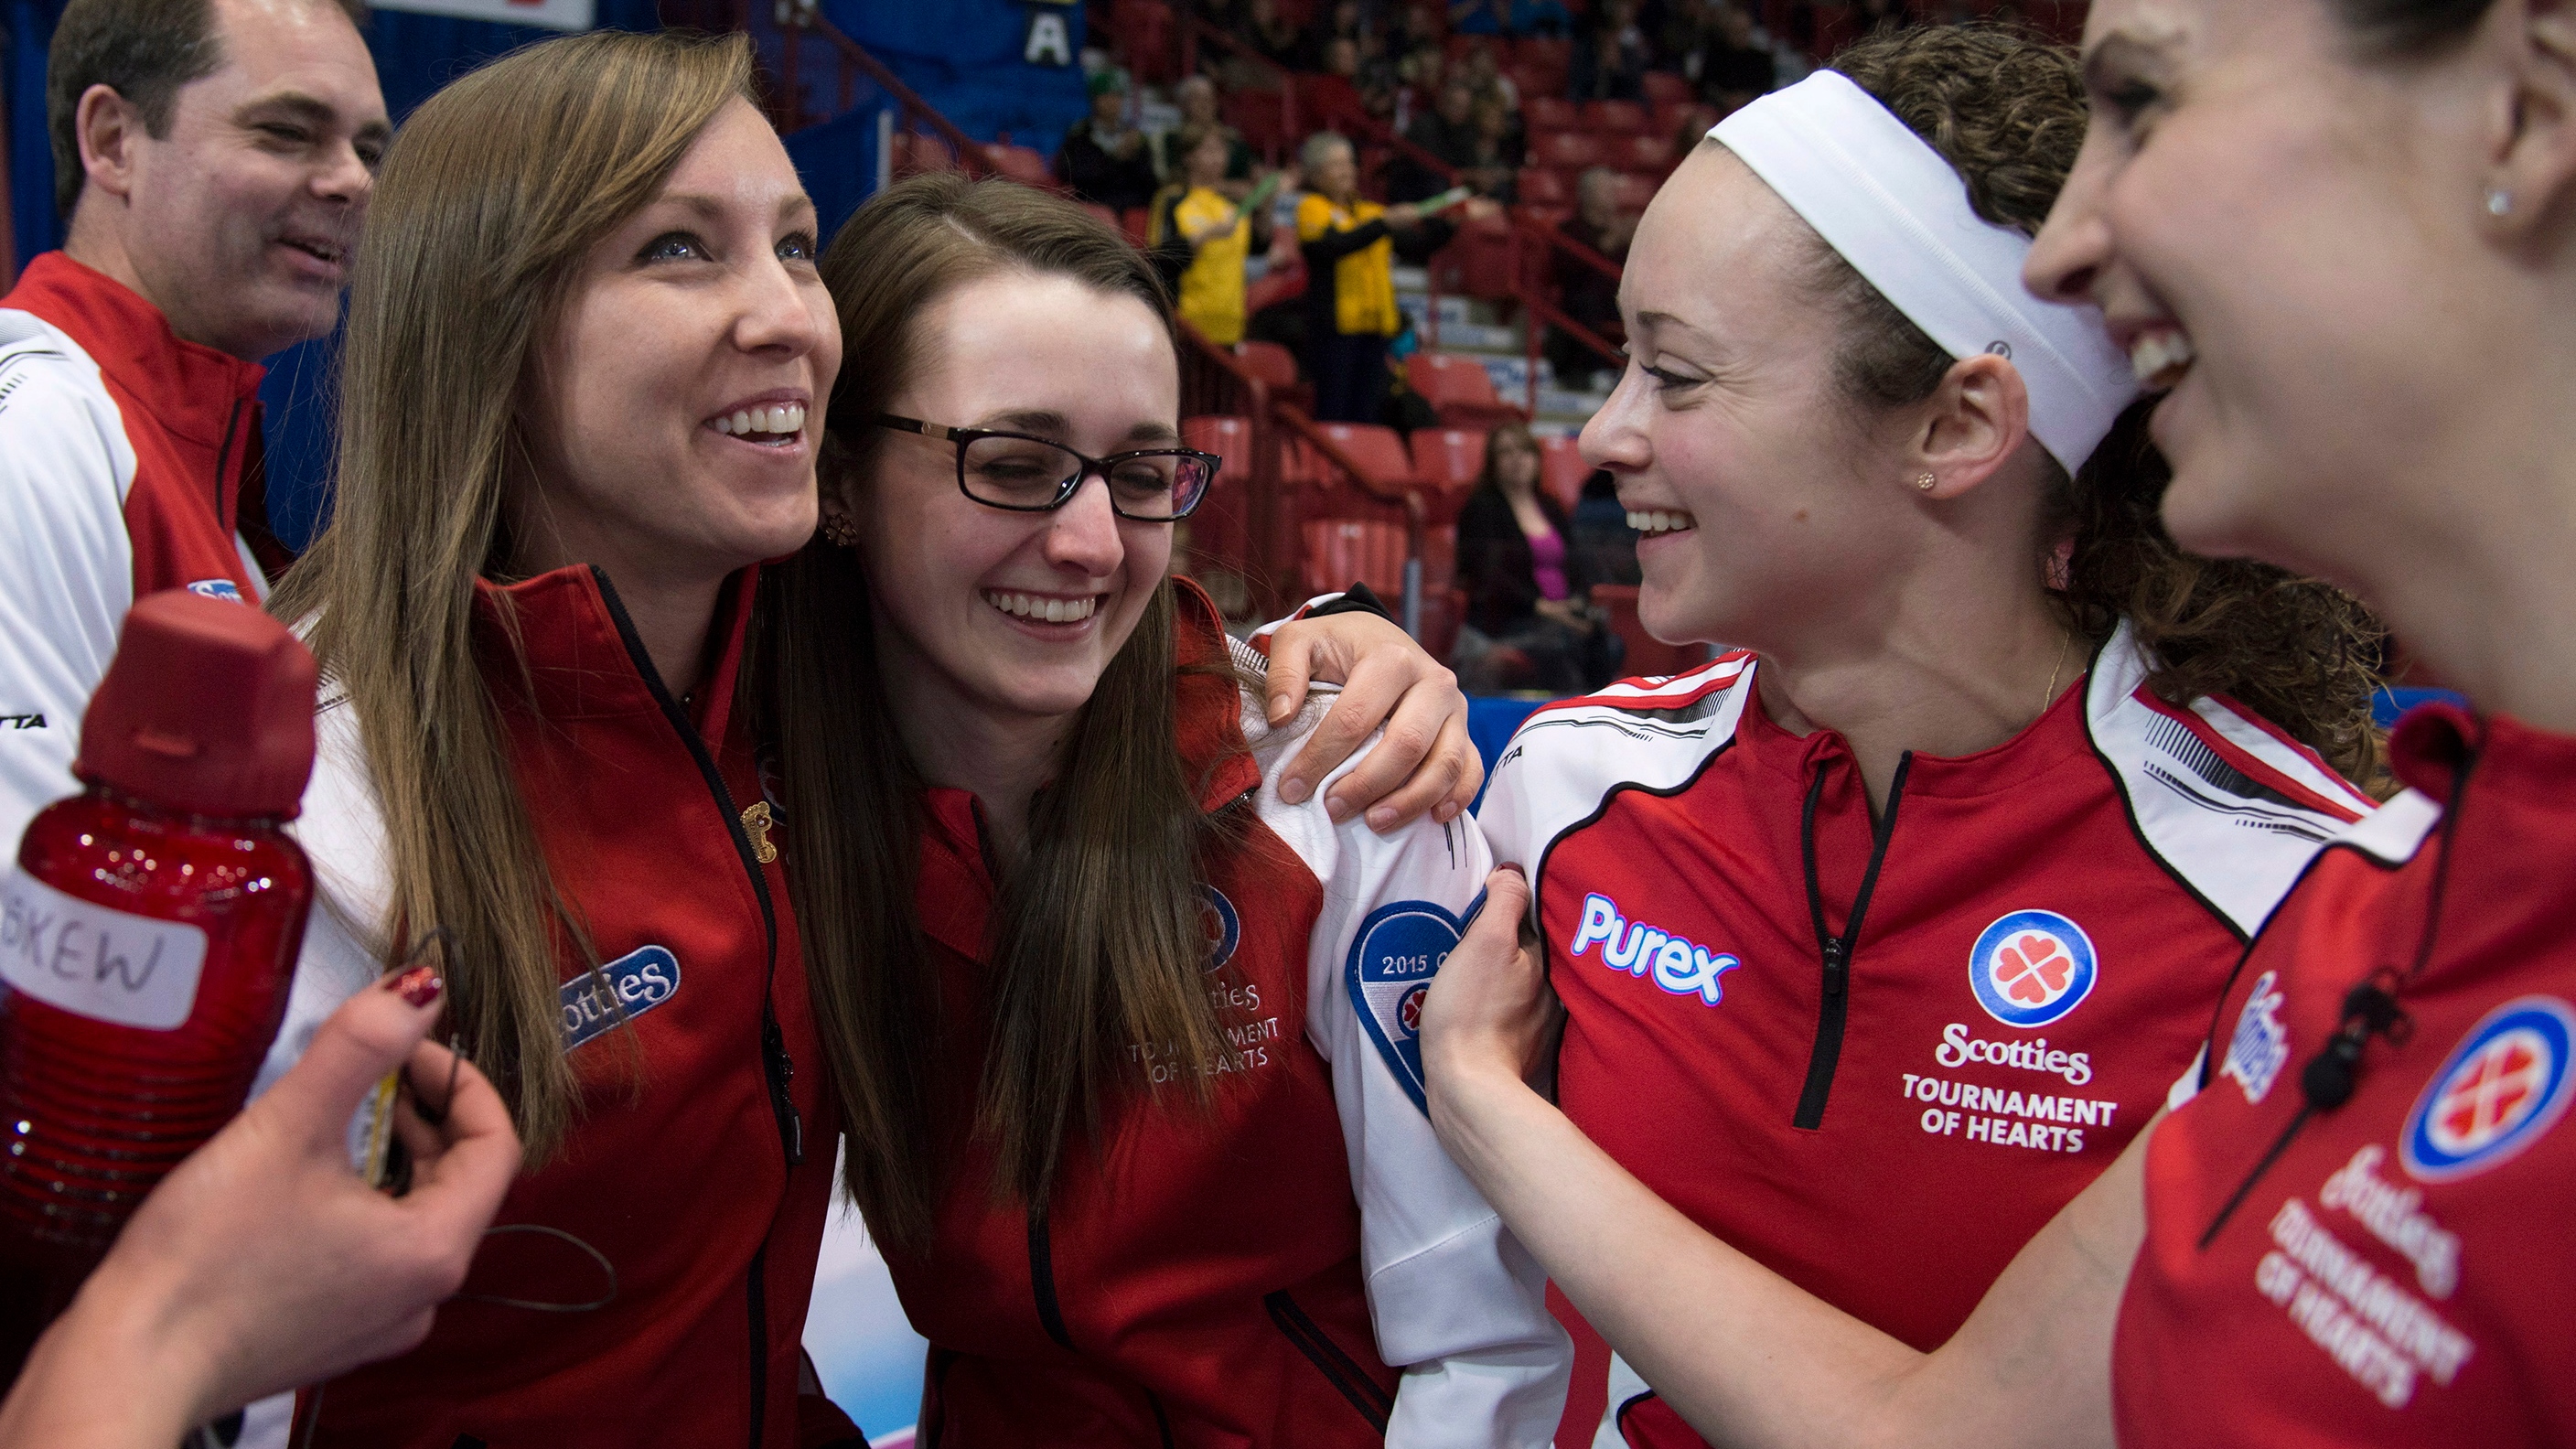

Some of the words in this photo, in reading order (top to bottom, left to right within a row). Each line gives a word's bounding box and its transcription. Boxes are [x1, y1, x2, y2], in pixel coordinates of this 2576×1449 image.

[1381, 954, 1428, 975] 2015
[1571, 892, 1740, 1007] Purex
[1935, 1023, 2092, 1086] Scotties
[1902, 1073, 2118, 1127] TOURNAMENT
[1920, 1108, 1961, 1136] OF
[1966, 1115, 2085, 1154] HEARTS
